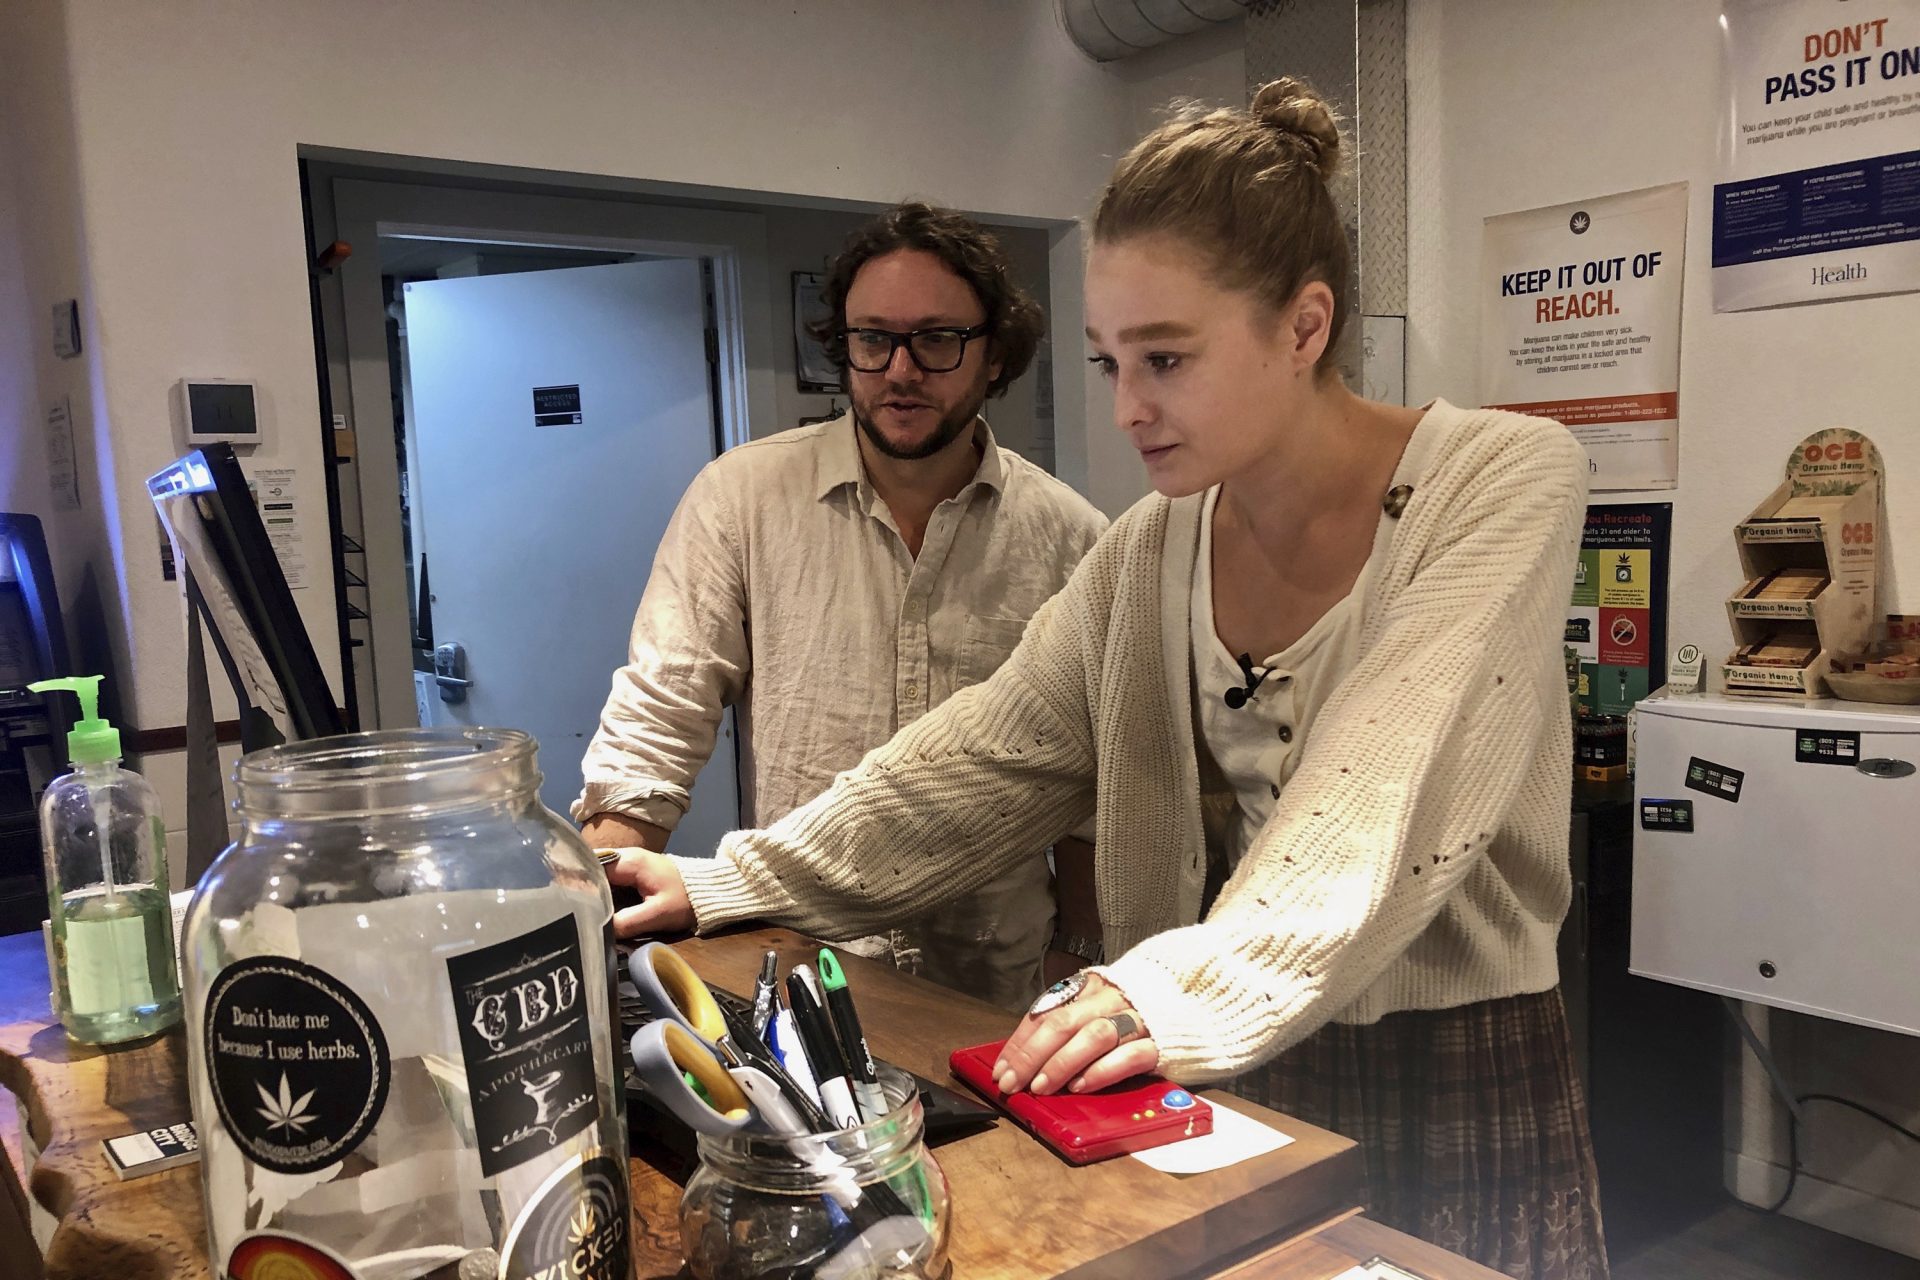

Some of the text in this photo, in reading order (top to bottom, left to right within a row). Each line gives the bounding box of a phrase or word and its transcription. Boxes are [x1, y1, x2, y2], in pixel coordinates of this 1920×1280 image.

[1804, 18, 1888, 62] DON'T
[1765, 46, 1920, 104] PASS IT ON
[1742, 124, 1756, 134] You
[1758, 120, 1772, 130] can
[1774, 117, 1792, 127] keep
[1795, 113, 1812, 125] your
[1814, 108, 1832, 120] child
[1854, 100, 1868, 111] and
[1747, 130, 1784, 144] marijuana
[1786, 126, 1806, 137] while
[1808, 124, 1822, 135] you
[1824, 120, 1838, 130] are
[1840, 112, 1876, 128] pregnant
[1502, 252, 1662, 297] KEEP IT OUT OF
[1812, 262, 1868, 286] Health
[1536, 289, 1620, 324] REACH.
[1523, 336, 1550, 344] Marijuana
[1605, 328, 1618, 336] very
[1576, 342, 1589, 350] your
[1616, 337, 1627, 345] and
[1552, 354, 1580, 362] marijuana
[1805, 442, 1862, 462] OCB
[1802, 462, 1864, 472] Organic Hemp
[1604, 514, 1653, 524] Recreate
[1749, 526, 1812, 536] Organic Hemp
[1740, 603, 1803, 612] Organic Hemp
[1731, 670, 1794, 681] Organic Hemp
[465, 986, 486, 1006] THE
[232, 1006, 330, 1029] Don't hate me
[472, 966, 579, 1051] CBD
[218, 1033, 360, 1060] because I use herbs.
[478, 1040, 590, 1102] APOTHECARY
[150, 1128, 177, 1146] CITY
